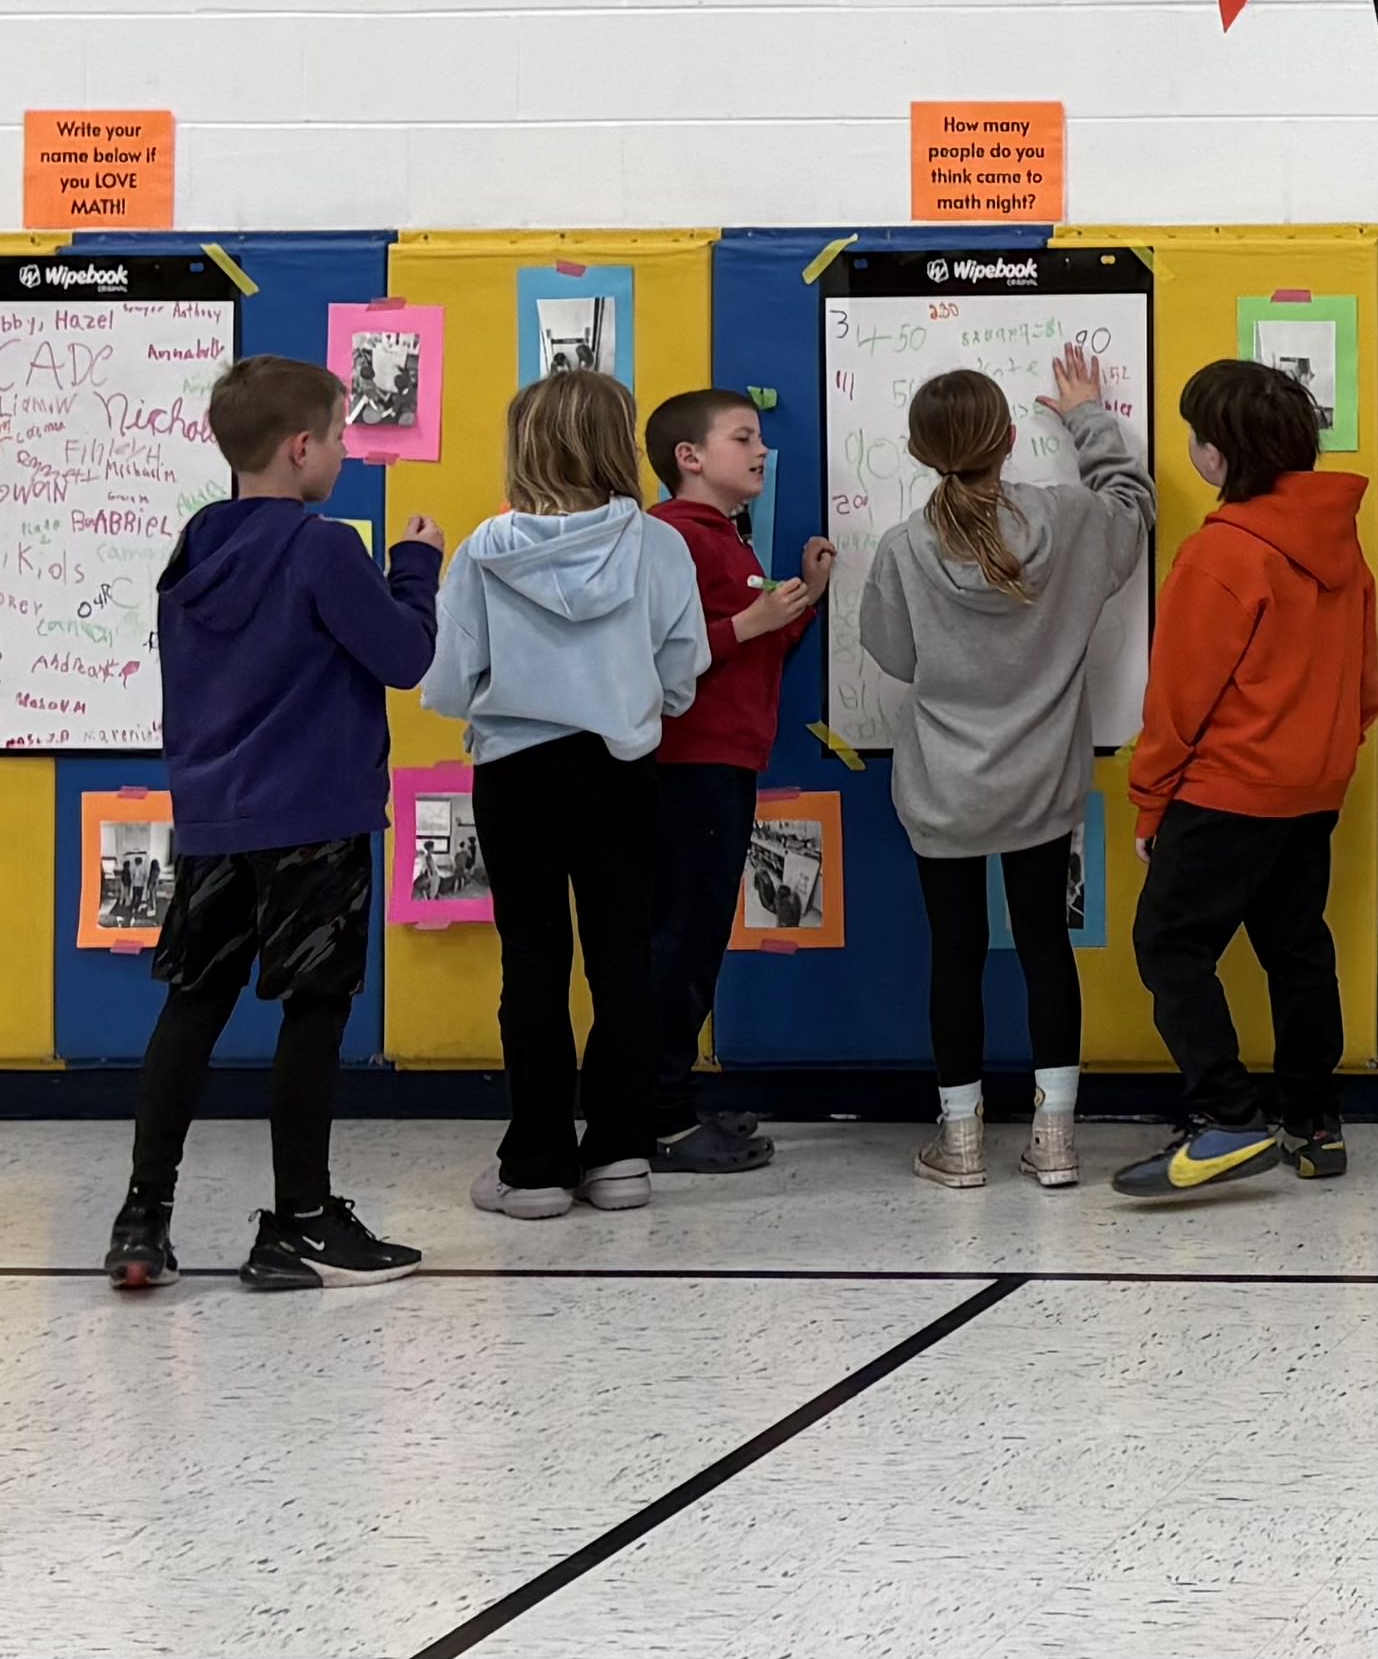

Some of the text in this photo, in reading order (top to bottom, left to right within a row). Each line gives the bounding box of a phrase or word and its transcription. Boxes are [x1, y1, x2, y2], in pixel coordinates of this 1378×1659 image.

[57, 121, 142, 141] Write your
[944, 116, 1029, 137] How many
[40, 147, 157, 163] name below if
[929, 142, 1045, 162] people do you
[60, 173, 137, 193] you LOVE
[931, 168, 1042, 184] think came to
[71, 199, 126, 215] MATH!
[937, 193, 1036, 214] math night?
[45, 263, 128, 290] Wipebook
[954, 257, 1038, 284] Wipebook
[0, 313, 43, 335] bby,
[56, 310, 113, 330] Hazel
[830, 310, 849, 339] 3
[1031, 437, 1060, 457] 110
